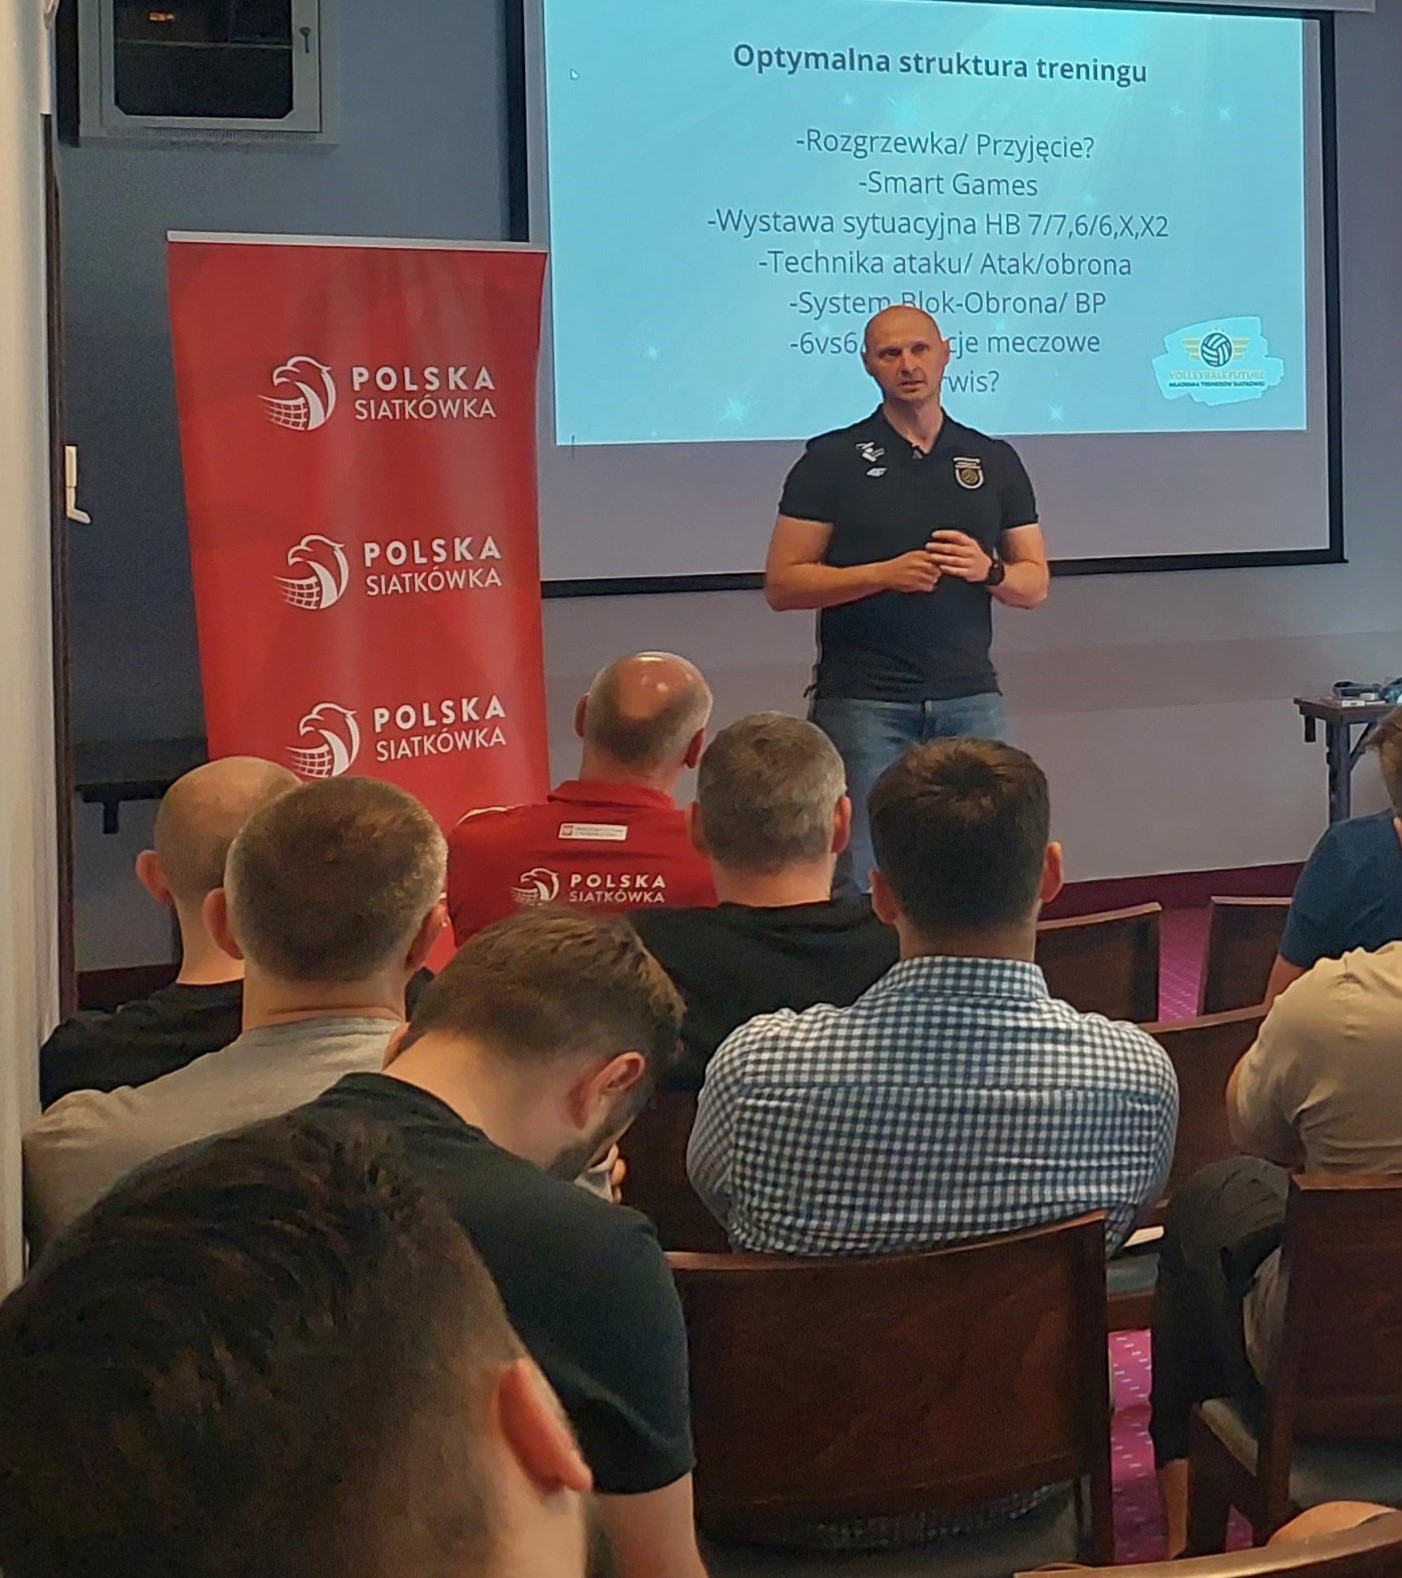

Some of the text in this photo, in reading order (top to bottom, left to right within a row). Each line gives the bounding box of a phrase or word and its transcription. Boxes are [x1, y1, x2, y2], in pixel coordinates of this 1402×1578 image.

[733, 43, 1147, 88] Optymalna struktura treningu
[795, 128, 1095, 163] -Rozgrzewka/ Przyjęcie?
[858, 170, 1038, 197] -Smart Games
[707, 208, 1169, 241] -Wystawa sytuacyjna HB 7/7,6/6,X,X2
[758, 249, 1132, 276] -Technika ataku/ Atak/obrona
[789, 290, 1106, 320] -System Blok-Obrona/ BP
[987, 334, 1100, 353] meczowe
[352, 366, 496, 391] POLSKA
[354, 394, 497, 420] SIATKÓWKA
[364, 535, 502, 567] POLSKA
[366, 566, 502, 596] SIATKÓWKA
[373, 694, 506, 733] POLSKA
[376, 725, 507, 762] SIATKÓWKA
[569, 888, 666, 903] SIATKÓWKA
[570, 873, 666, 889] POLSKA
